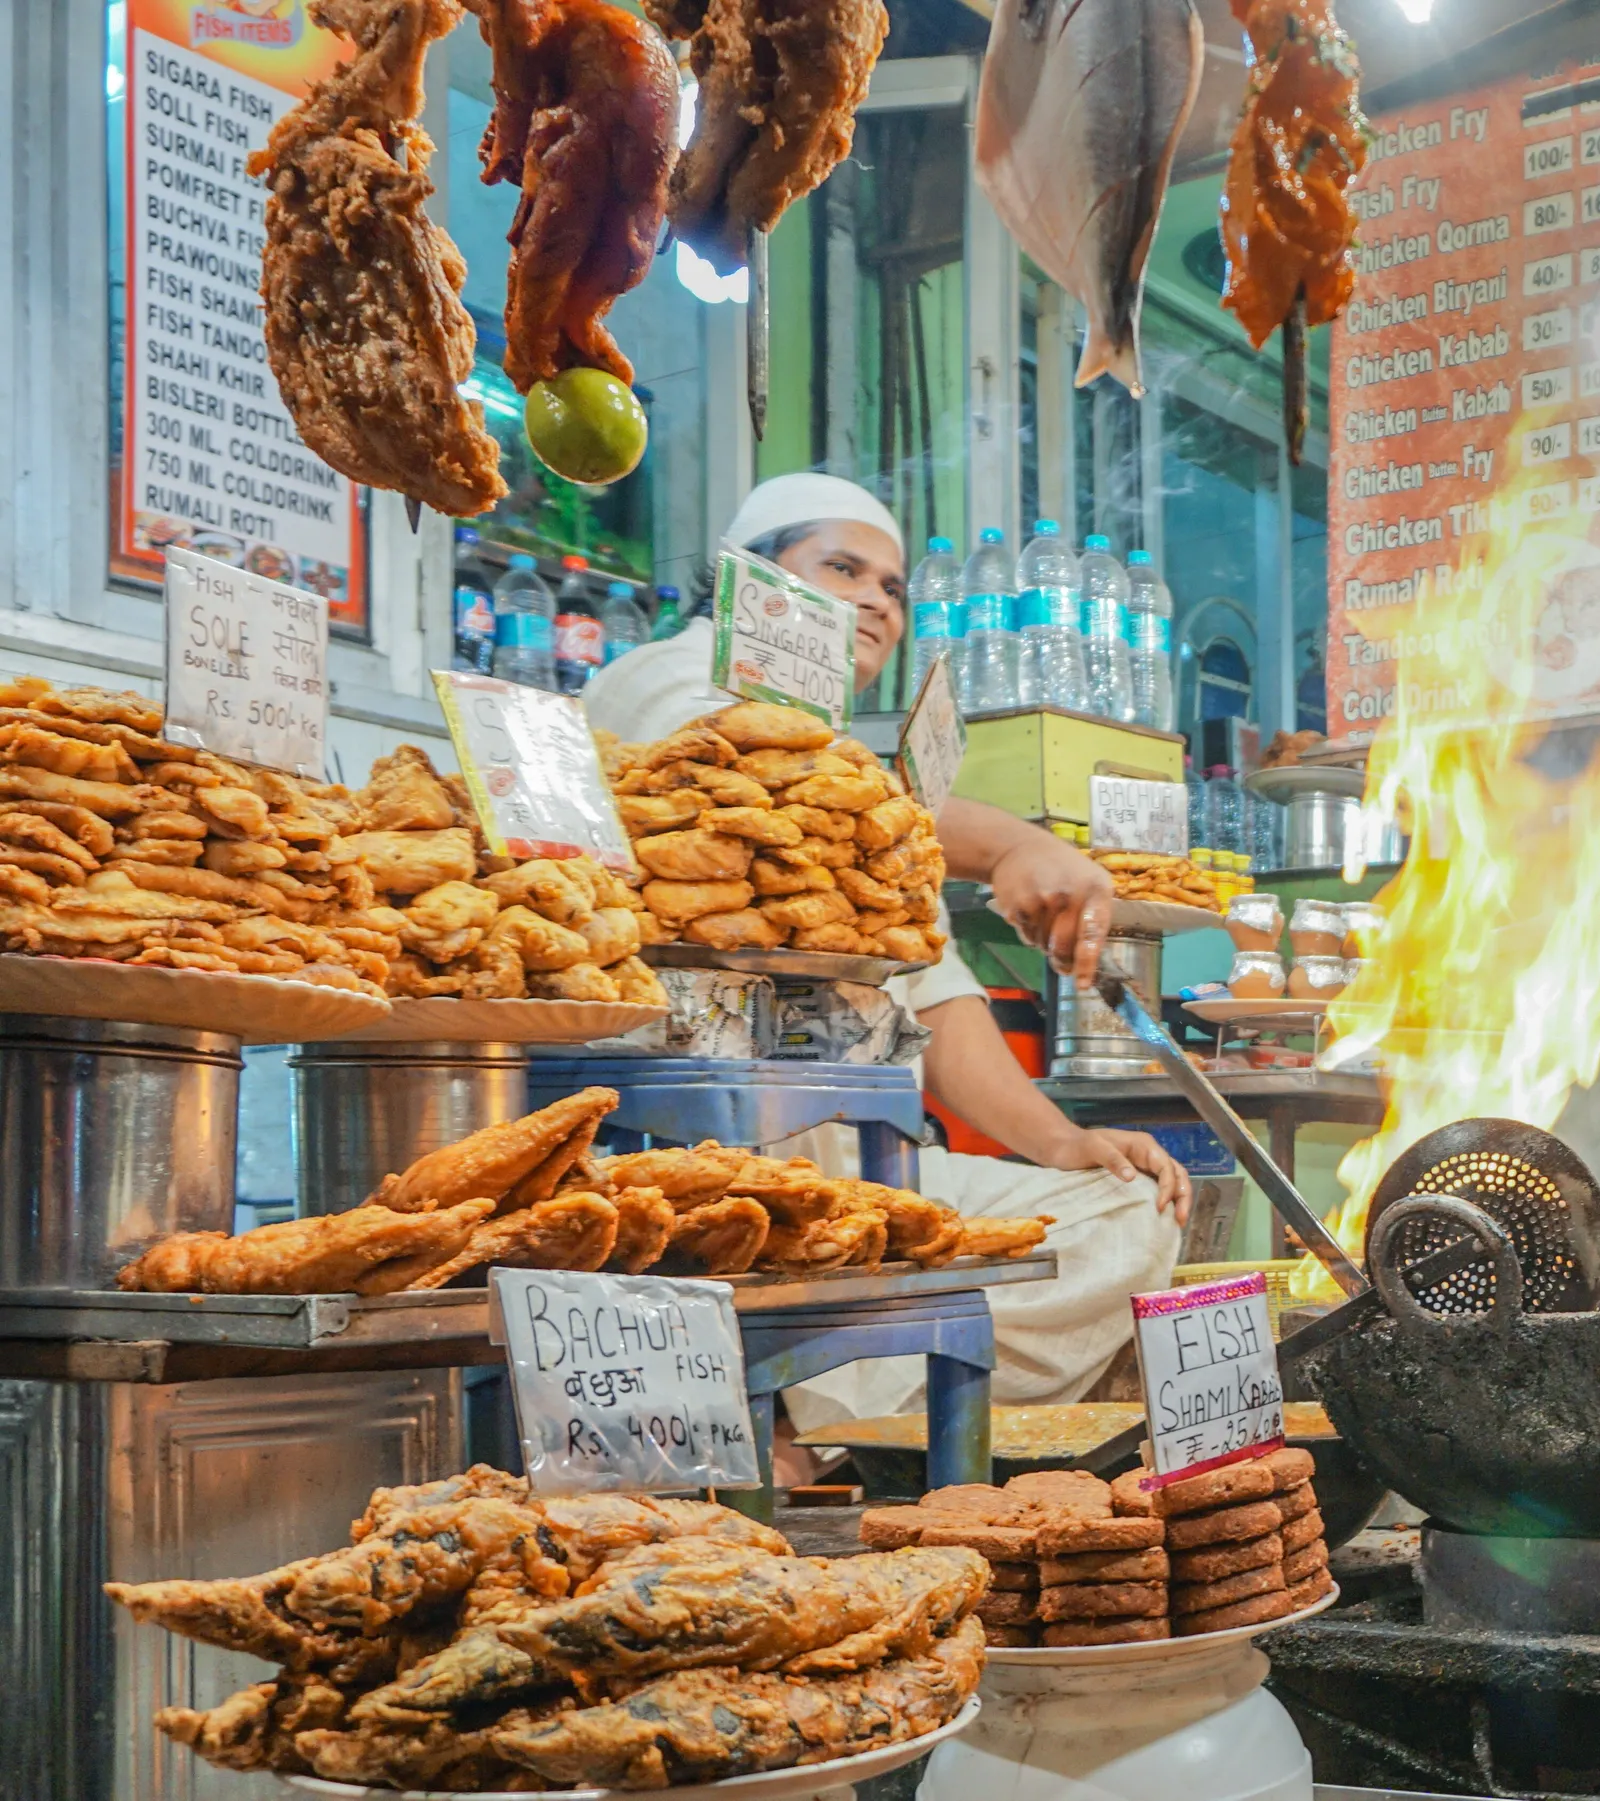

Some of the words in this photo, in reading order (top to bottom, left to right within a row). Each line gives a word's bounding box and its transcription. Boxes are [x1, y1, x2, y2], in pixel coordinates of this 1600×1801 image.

[194, 11, 235, 38] FISH
[239, 19, 293, 44] ITEMS
[146, 50, 222, 103] SIGARA
[229, 87, 273, 124] FISH
[146, 87, 197, 128] SOLL
[205, 113, 249, 150] FISH
[1367, 120, 1442, 165] icken
[1450, 106, 1489, 143] Fry
[1528, 145, 1570, 172] 100/-
[146, 122, 225, 175] SURMAI
[147, 158, 241, 211] POMFRET
[1349, 181, 1395, 220] Fish
[1402, 174, 1442, 212] Fry
[1534, 202, 1566, 228] 80/-
[147, 194, 231, 247] BUCHVA
[237, 228, 264, 258] FIS
[1437, 213, 1511, 253] Qorma
[147, 231, 261, 291] PRAWOUNS
[147, 267, 194, 303] FISH
[200, 285, 262, 328] SHAMI
[1346, 291, 1428, 335] Chicken
[1433, 266, 1508, 316] Biryani
[147, 303, 194, 340] FISH
[200, 321, 266, 364] TANDO
[1346, 347, 1433, 387] Chicken
[1438, 323, 1511, 369] Kabab
[147, 340, 210, 381] SHAHI
[217, 361, 265, 399] KHIR
[147, 375, 225, 421] BISLERI
[1345, 404, 1417, 444] Chicken
[1452, 379, 1512, 423] Kabab
[147, 412, 182, 443] 300
[229, 438, 340, 492] COLDDRINK
[1345, 460, 1424, 500] Chicken
[1462, 444, 1494, 483] Fry
[146, 448, 182, 479] 750
[223, 471, 334, 524] COLDDRINK
[146, 485, 223, 528] RUMALI
[230, 509, 275, 541] ROTI
[1345, 515, 1442, 556] Chicken
[195, 567, 234, 603] FISH
[190, 605, 254, 658] SOLE
[734, 583, 833, 669] SINGARA
[184, 649, 250, 681] BONELESS
[1343, 685, 1398, 722] Cold
[1098, 781, 1173, 811] BACHUA
[525, 1284, 690, 1372] BACHUA
[1172, 1305, 1260, 1375] FISH
[676, 1354, 727, 1384] FISH
[1159, 1380, 1232, 1432] SHAMI
